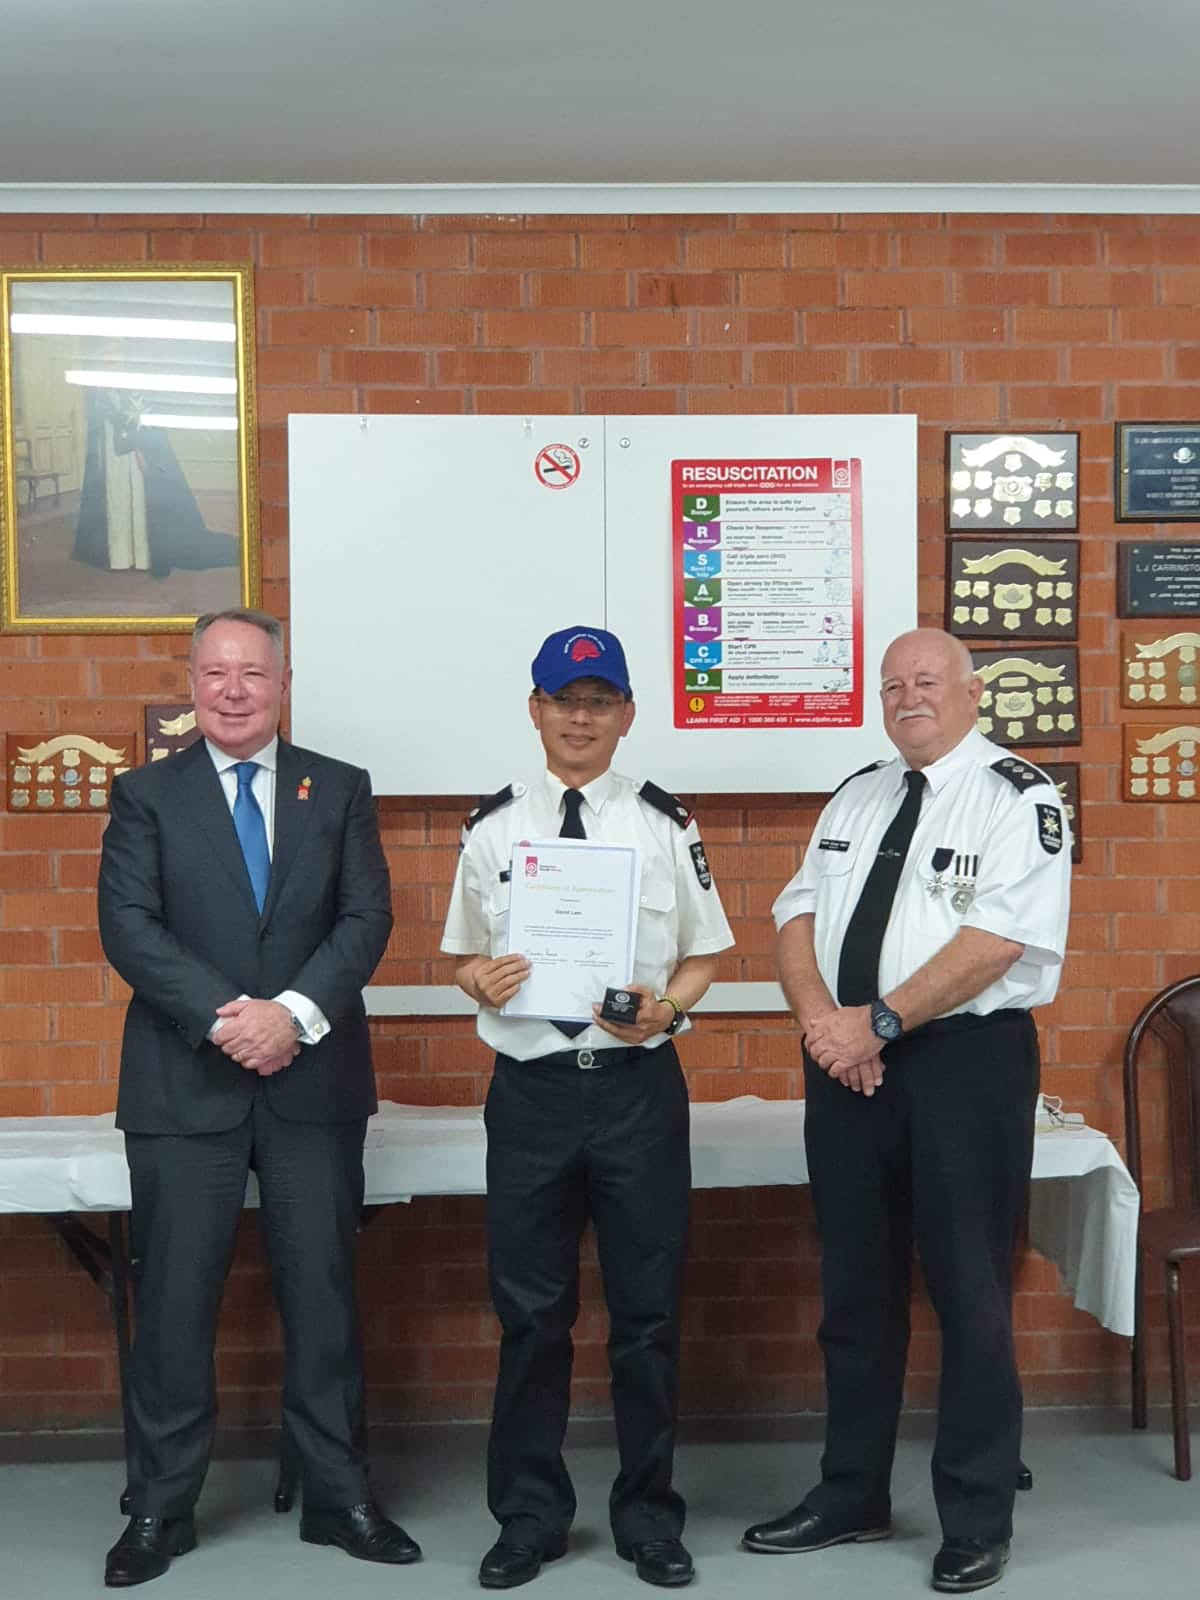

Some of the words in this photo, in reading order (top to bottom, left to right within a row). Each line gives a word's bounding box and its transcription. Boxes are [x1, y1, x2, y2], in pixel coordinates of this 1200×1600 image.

[682, 466, 818, 481] RESUSCITATION
[696, 498, 708, 509] D
[697, 526, 708, 538] R
[697, 554, 708, 565] S
[697, 584, 709, 595] A
[698, 614, 709, 625] B
[698, 646, 709, 657] C
[697, 673, 709, 684] D
